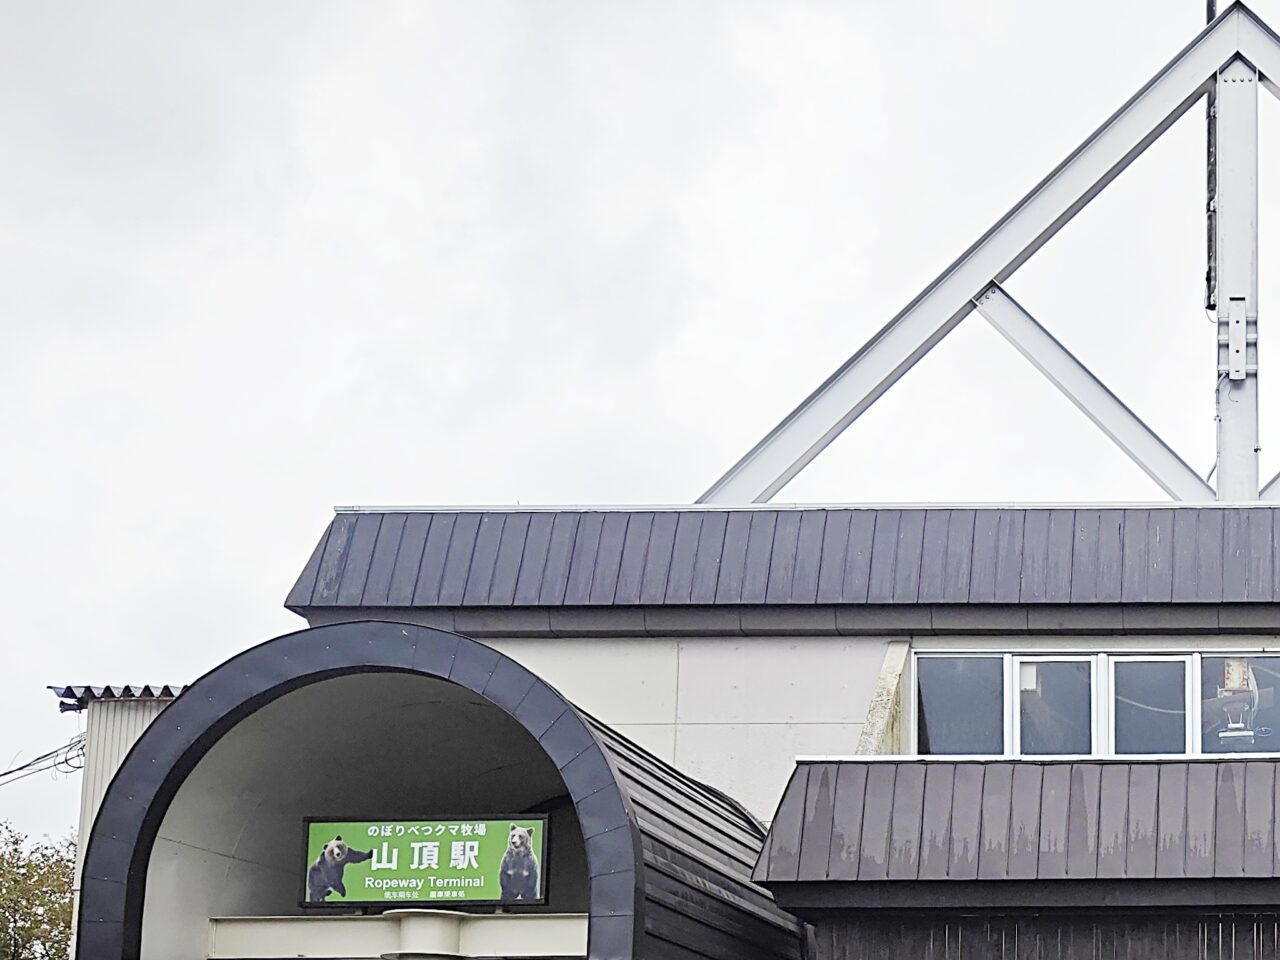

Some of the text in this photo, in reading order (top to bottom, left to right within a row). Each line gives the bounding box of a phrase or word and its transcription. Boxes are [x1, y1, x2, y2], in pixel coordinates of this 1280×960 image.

[367, 823, 486, 837] のぼりべつクマ牧場
[371, 841, 479, 870] 山頂駅
[364, 876, 485, 890] Ropeway Terminal
